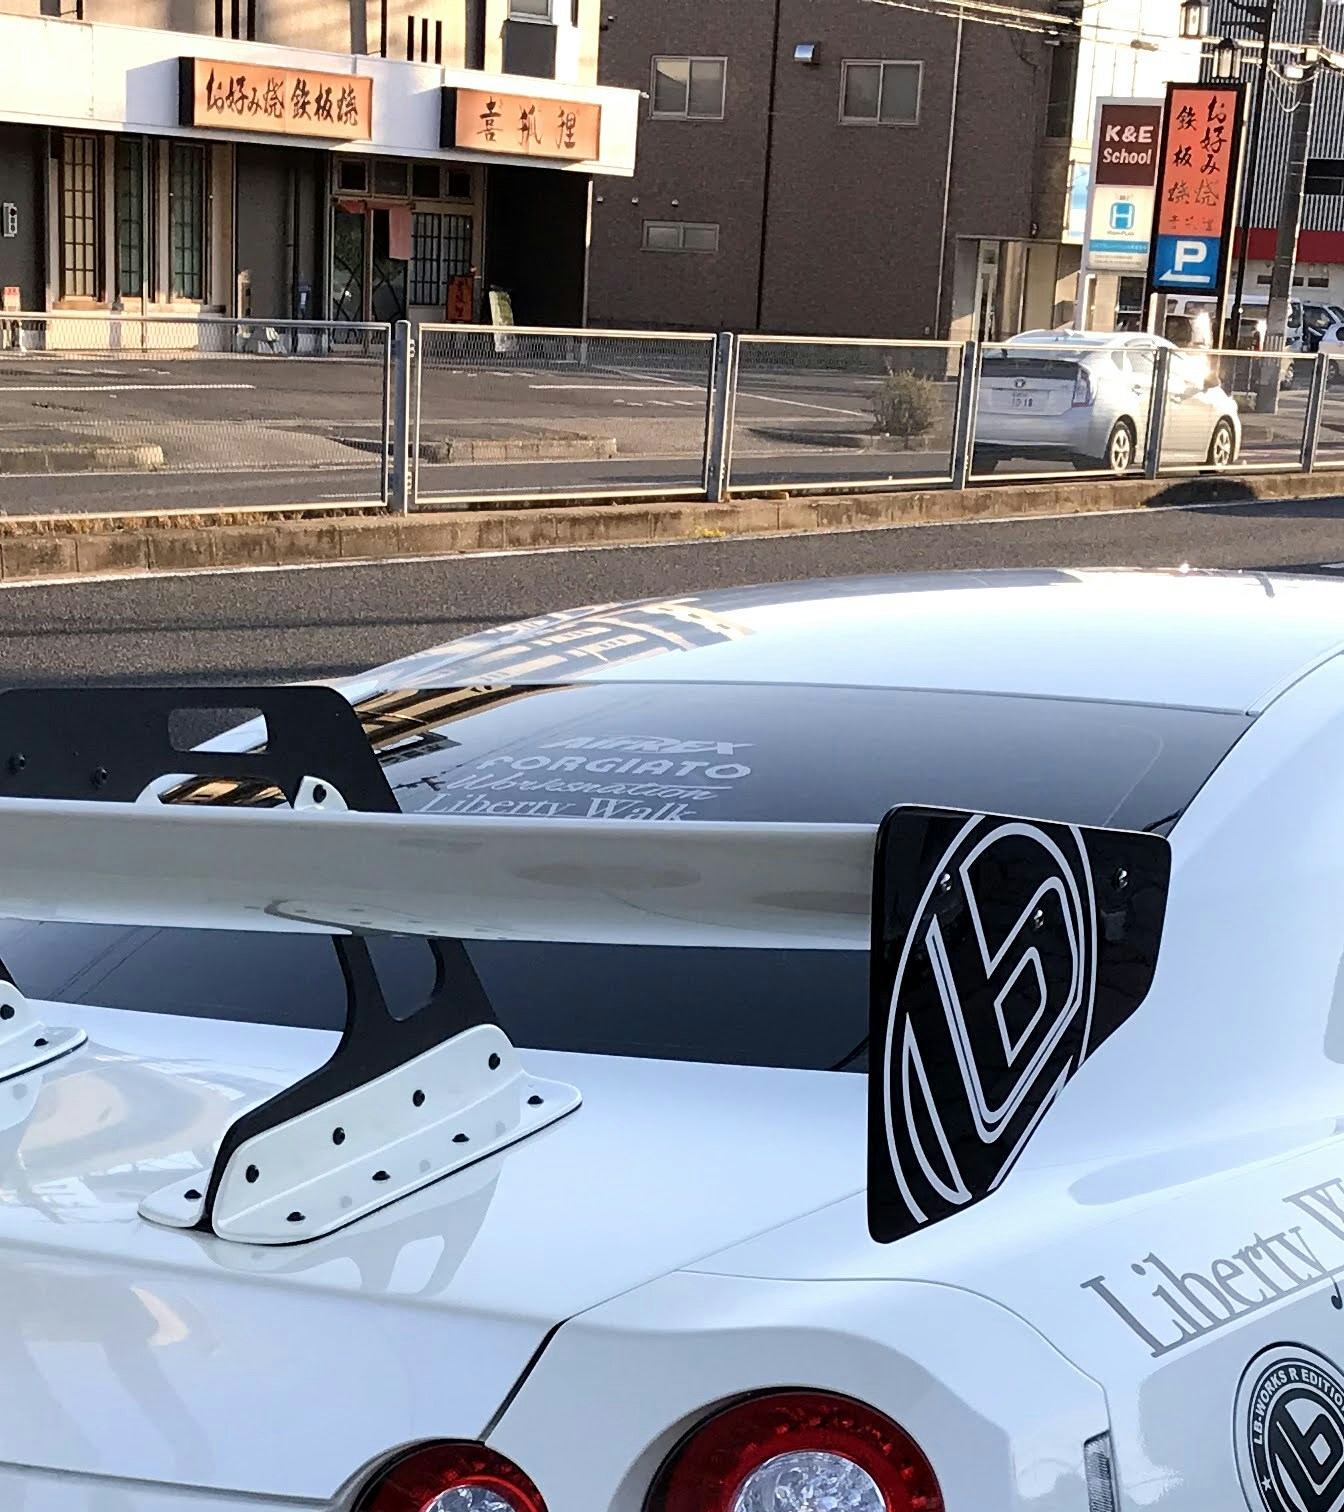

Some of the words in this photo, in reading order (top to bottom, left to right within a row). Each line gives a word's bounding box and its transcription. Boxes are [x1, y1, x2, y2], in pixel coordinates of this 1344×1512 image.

[1105, 125, 1154, 143] K&E
[1103, 147, 1152, 165] School
[1174, 240, 1208, 271] P
[477, 755, 752, 779] FORGIATO
[586, 797, 698, 822] Walk
[1080, 1226, 1343, 1358] Liberty
[1253, 1368, 1288, 1446] LB-WORKS
[1290, 1368, 1301, 1381] R
